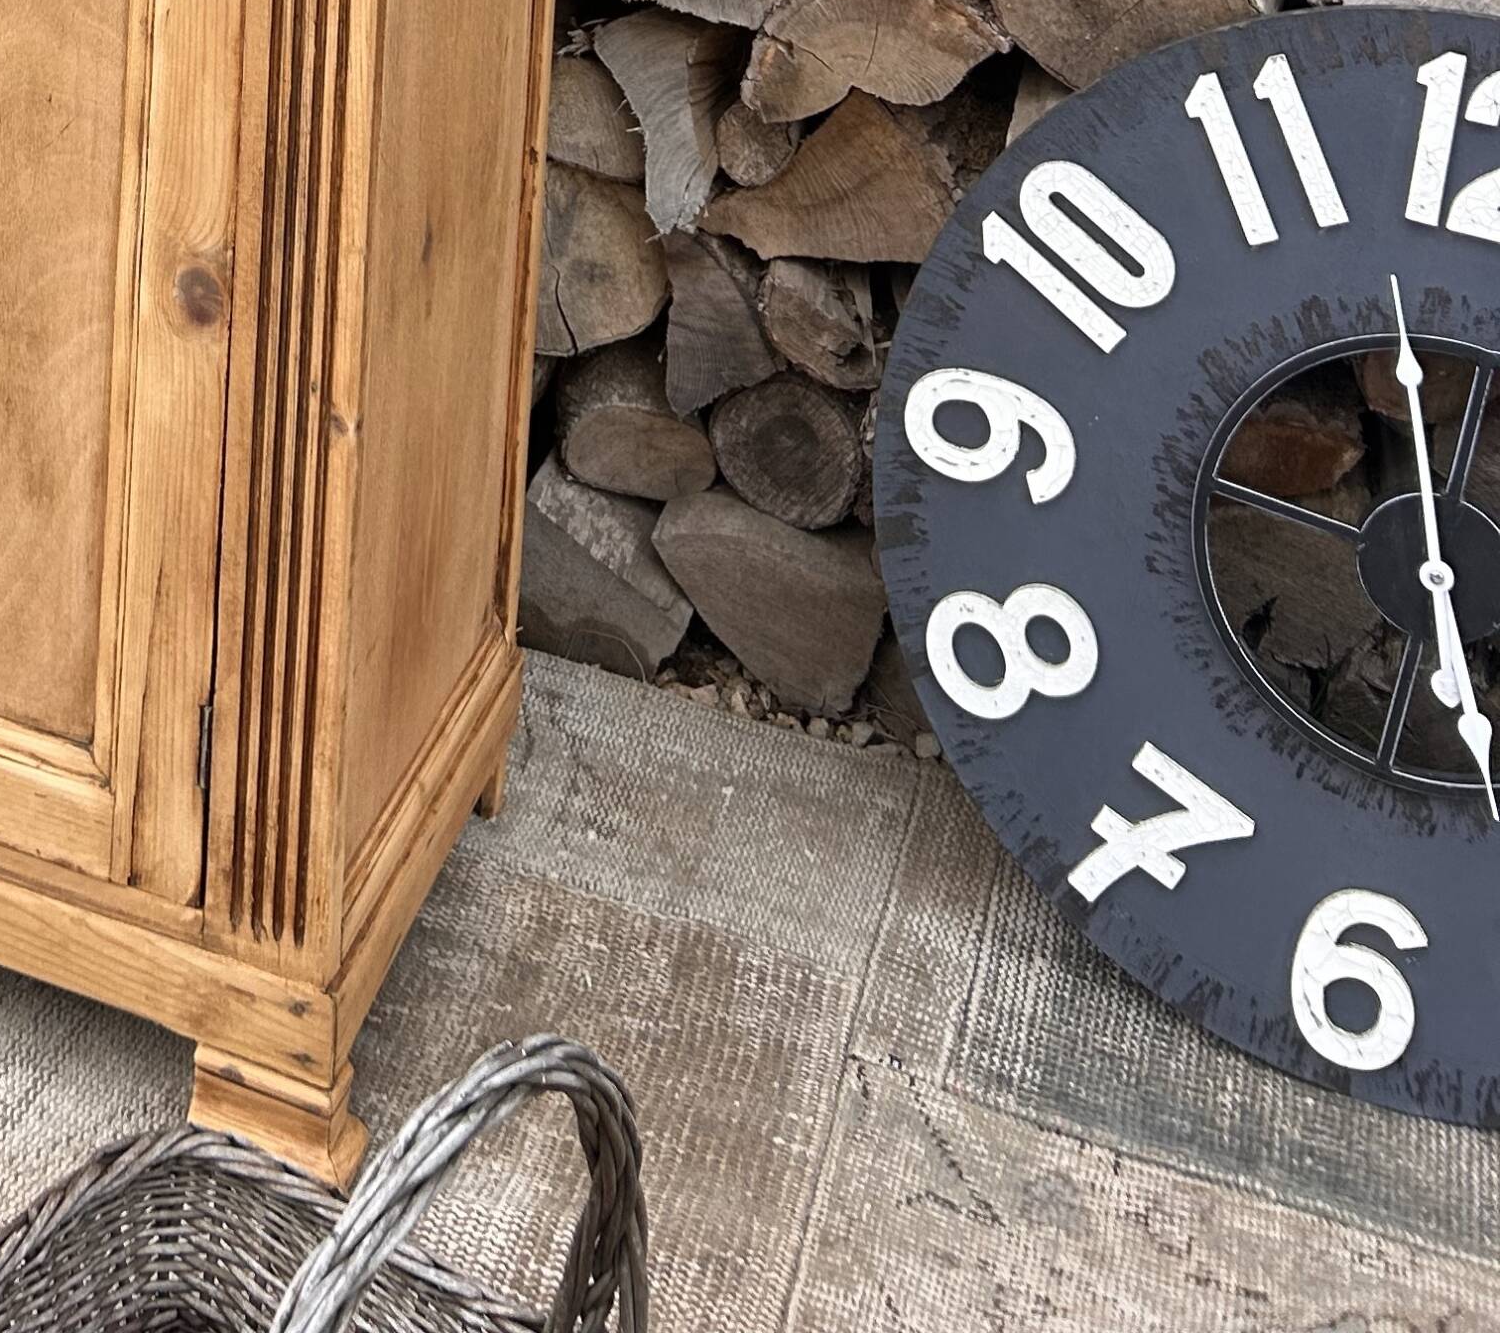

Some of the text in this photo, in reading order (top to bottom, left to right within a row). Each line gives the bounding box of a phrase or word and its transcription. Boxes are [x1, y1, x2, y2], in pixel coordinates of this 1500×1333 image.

[1184, 53, 1350, 246] 11
[981, 159, 1176, 354] 10
[904, 367, 1077, 505] 9
[925, 583, 1099, 720] 8
[1067, 740, 1256, 903] 7
[1290, 889, 1429, 1071] 6
